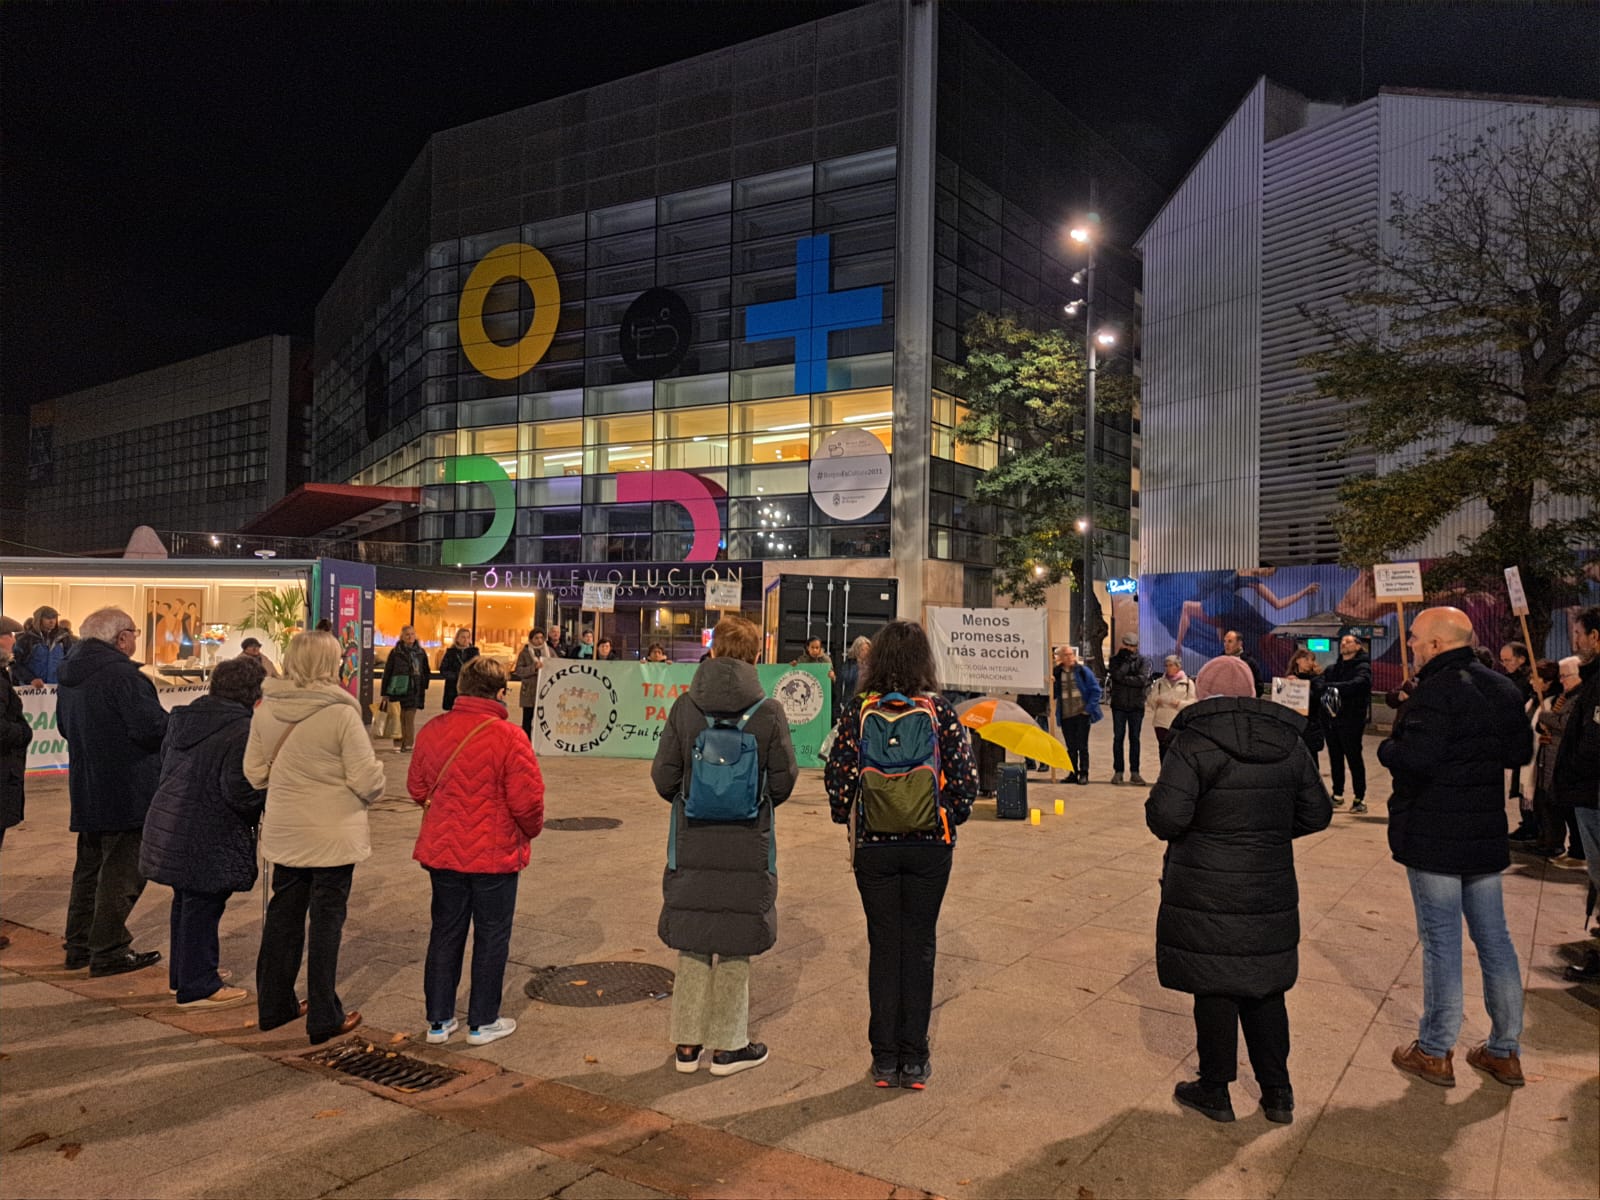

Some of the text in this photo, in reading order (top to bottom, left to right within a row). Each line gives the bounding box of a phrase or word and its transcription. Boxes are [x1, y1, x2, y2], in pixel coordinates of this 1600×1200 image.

[470, 564, 742, 589] FÓRUM EVOLUCIÓN
[962, 614, 1010, 627] Menos
[951, 631, 1025, 645] promesas,
[946, 644, 1029, 659] más acción
[988, 665, 1019, 673] INTEGRAL
[538, 664, 618, 705] CIRCULOS
[537, 705, 618, 753] DEL SILENCIO
